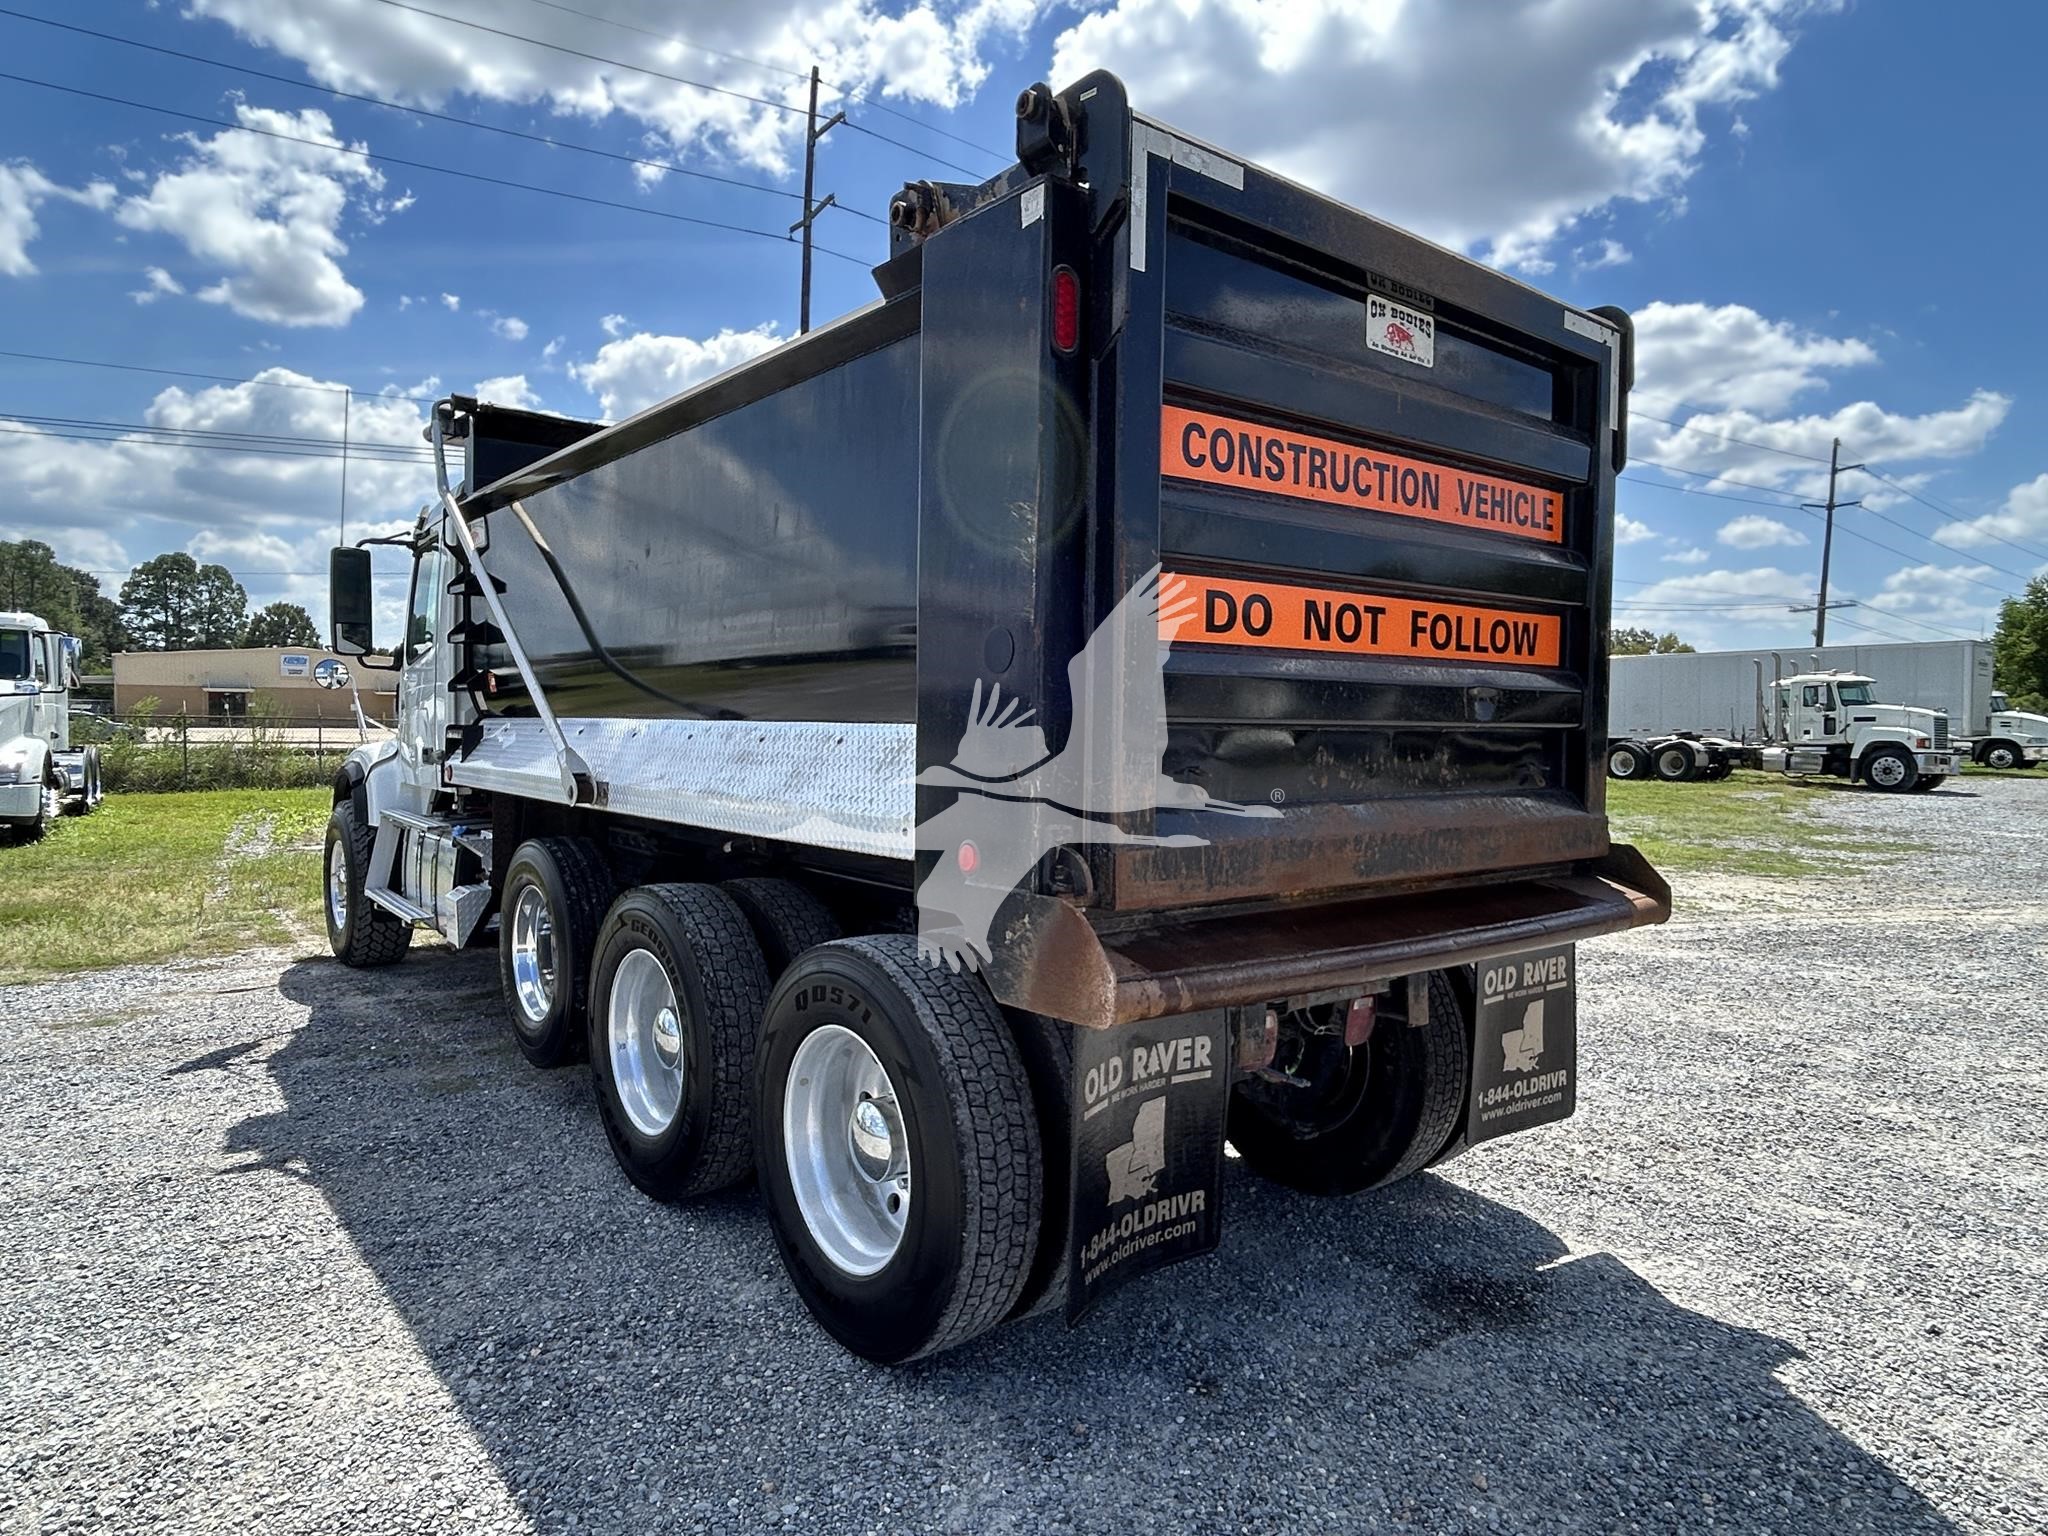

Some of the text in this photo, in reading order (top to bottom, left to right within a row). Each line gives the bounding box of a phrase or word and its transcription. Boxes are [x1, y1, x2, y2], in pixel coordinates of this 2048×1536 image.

[1370, 300, 1432, 339] OX BODIES
[1182, 422, 1554, 532] CONSTRUCTION VEHICLE
[1205, 589, 1539, 656] DO NOT FOLLOW
[1484, 965, 1517, 995] OLD
[1084, 1056, 1123, 1104] OLD
[1478, 1069, 1567, 1109] 1-844-OLDRIVR
[1481, 1092, 1562, 1122] www.oldriver.com
[1081, 1190, 1205, 1269] 1-844-OLDRIVR
[1085, 1220, 1196, 1285] www.oldriver.com
